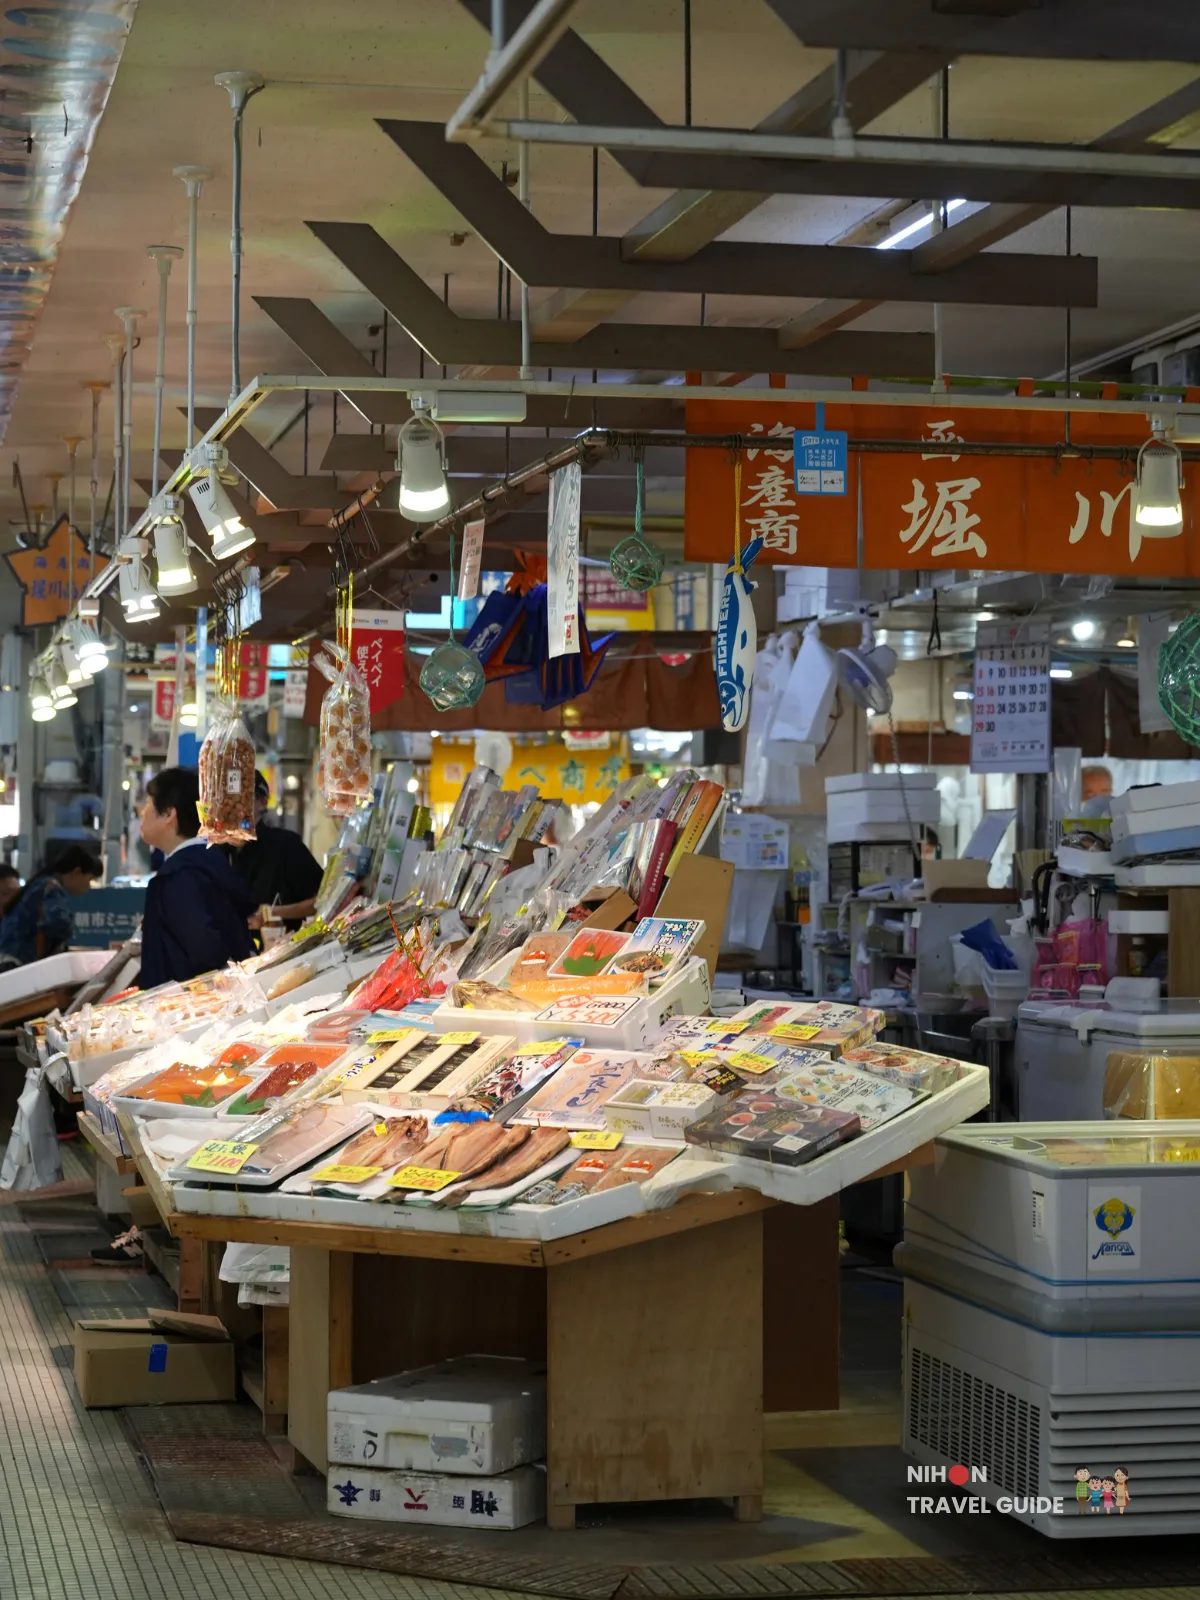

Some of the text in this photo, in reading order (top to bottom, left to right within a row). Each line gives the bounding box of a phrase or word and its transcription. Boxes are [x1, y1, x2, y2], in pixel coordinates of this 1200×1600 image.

[718, 584, 732, 677] FIGHTERS
[371, 637, 383, 688] ペイペイ
[978, 665, 1046, 679] 8 9 10 11 12 13 14
[977, 683, 1046, 697] 15 16 17 18 19 20 21
[976, 702, 1046, 715] 22 23 24 25 26 27 28
[976, 722, 994, 732] 29 30
